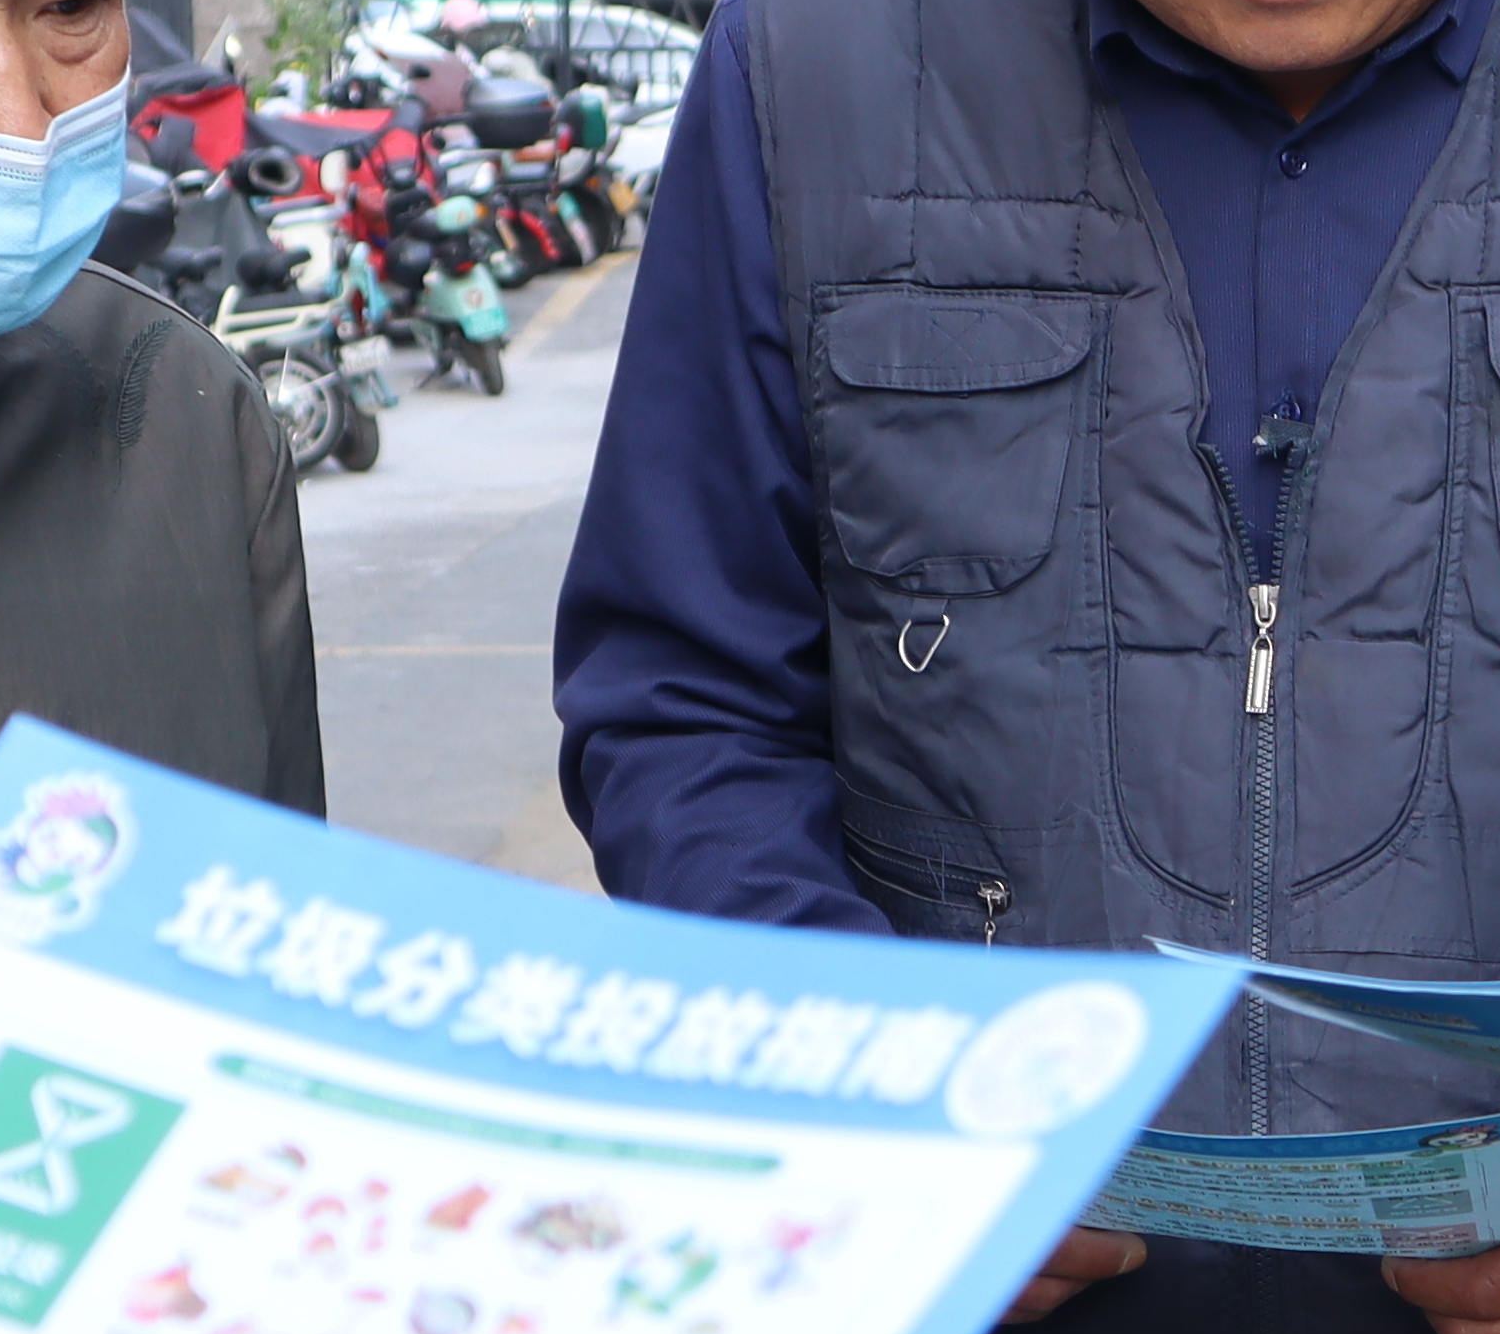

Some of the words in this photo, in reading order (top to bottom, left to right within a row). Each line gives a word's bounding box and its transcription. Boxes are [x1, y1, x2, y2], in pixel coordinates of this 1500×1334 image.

[155, 866, 973, 1106] 垃圾分类投放指南
